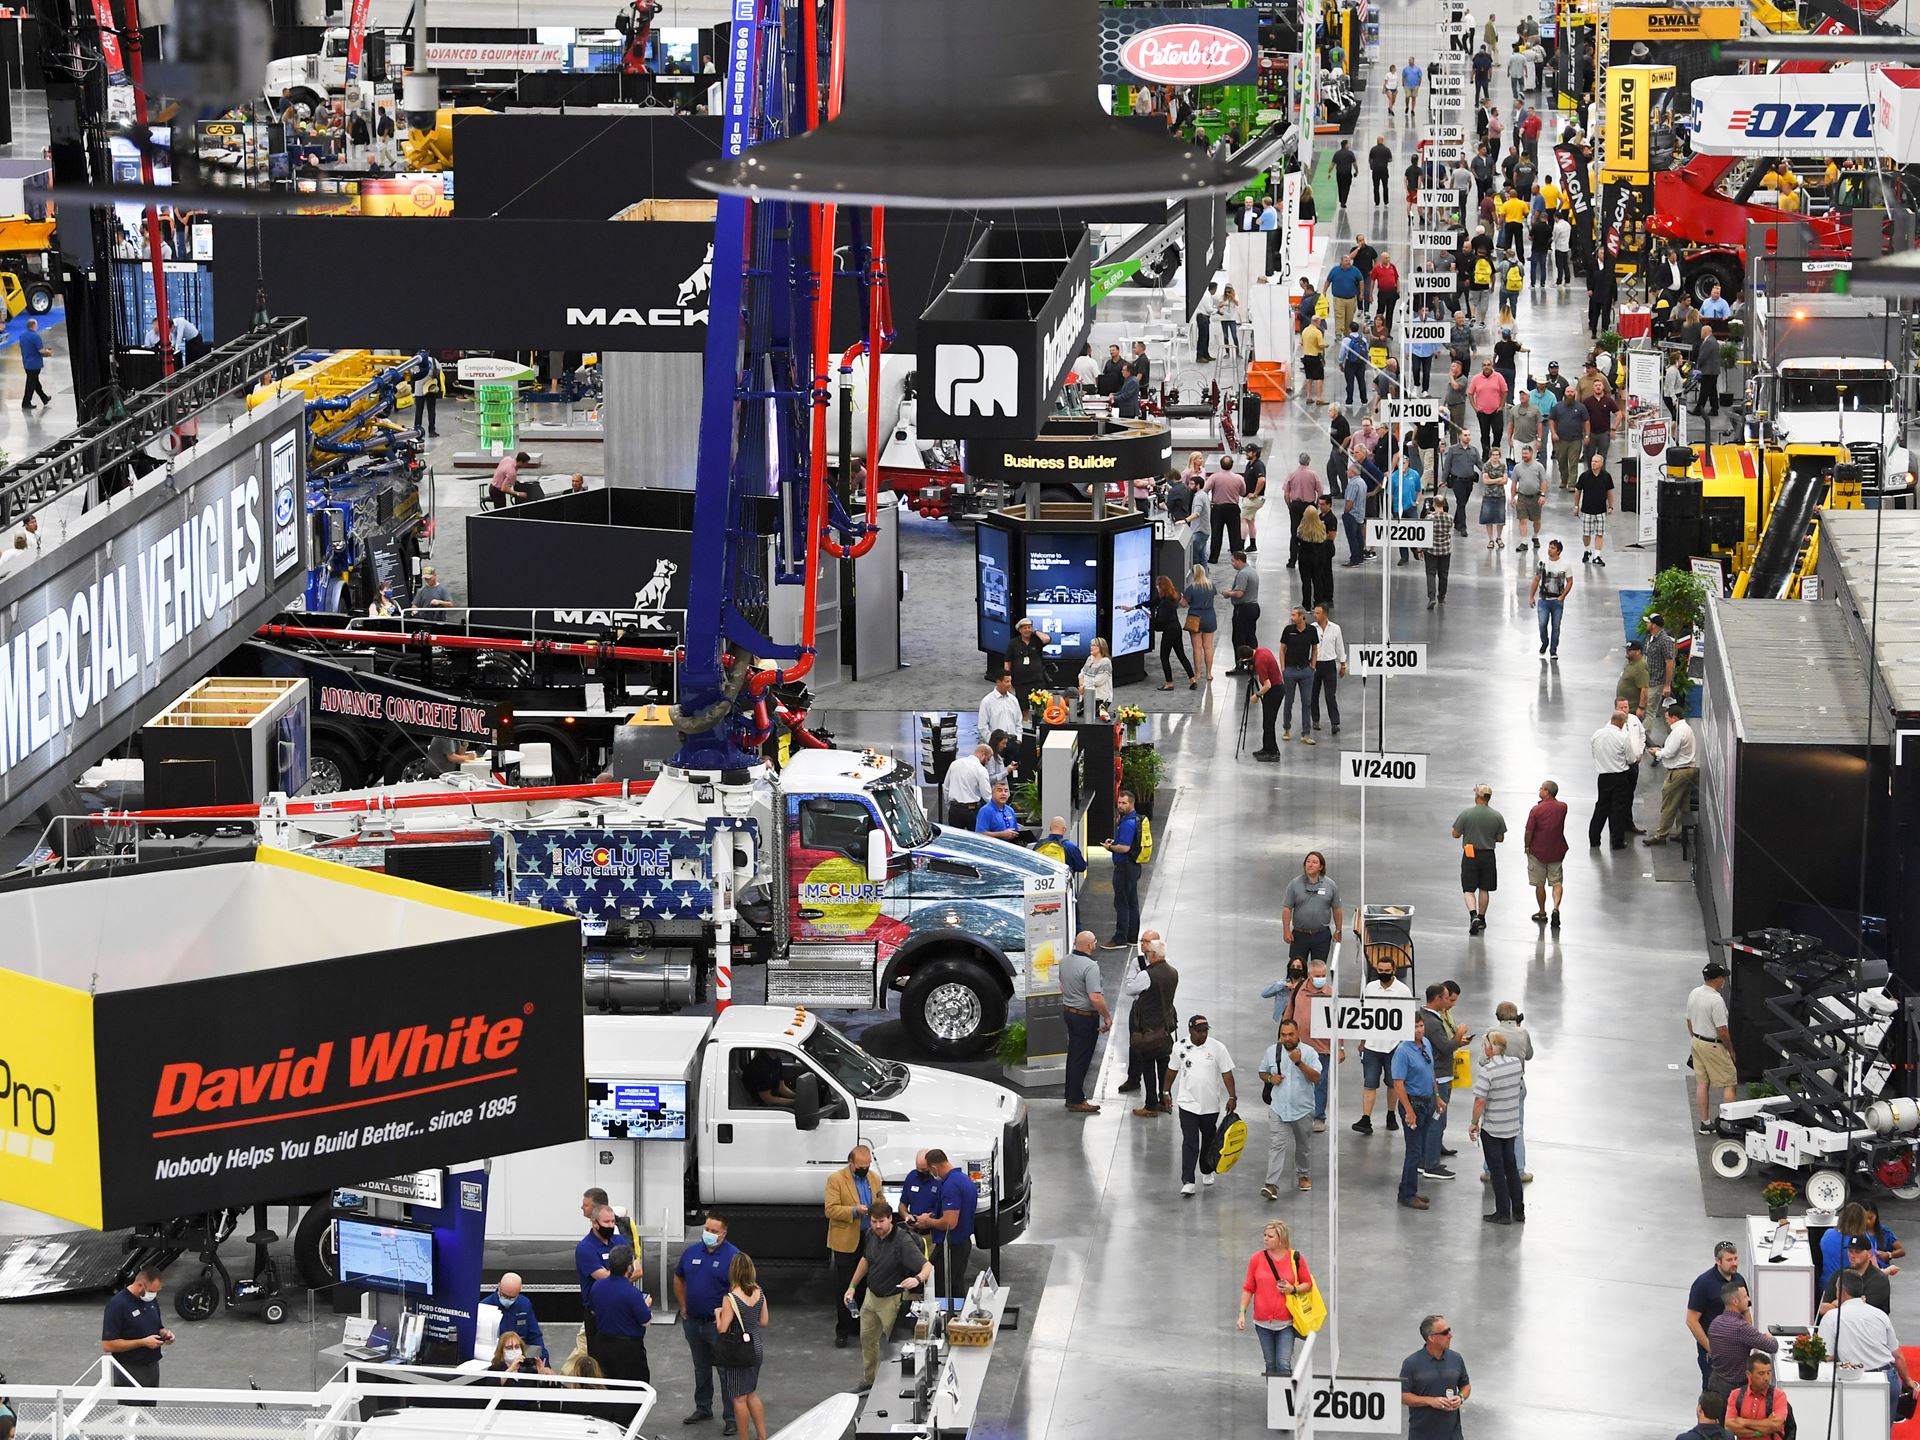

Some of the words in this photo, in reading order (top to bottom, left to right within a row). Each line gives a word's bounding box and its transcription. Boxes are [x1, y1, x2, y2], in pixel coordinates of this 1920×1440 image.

[480, 49, 539, 61] EQUIPMENT
[1138, 38, 1239, 69] Peterbilt
[733, 27, 749, 115] CONCRETE
[1621, 78, 1634, 161] DEWALT
[730, 122, 742, 155] INC
[1791, 149, 1822, 157] Concrete
[1558, 151, 1588, 214] MAGNI
[1607, 187, 1631, 255] MAGNI
[1103, 269, 1124, 289] BLEND
[1415, 276, 1451, 288] W1900
[464, 364, 494, 372] Composite
[495, 364, 516, 373] Springs
[274, 445, 294, 491] BUILT
[1004, 453, 1065, 469] Business
[1067, 455, 1118, 469] Builder
[275, 522, 296, 560] TOUGH
[138, 474, 262, 667] VEHICLES
[1359, 650, 1418, 668] W2300
[320, 687, 381, 719] ADVANCE
[386, 696, 459, 729] CONCRETE
[460, 704, 490, 734] INC.
[1352, 759, 1416, 780] W2400
[564, 848, 669, 867] McCLURE
[564, 866, 635, 876] CONCRETE
[640, 866, 670, 876] INC.
[807, 884, 884, 897] McCLURE
[1034, 878, 1055, 891] 39Z
[1324, 1006, 1403, 1031] W2500
[152, 1040, 335, 1118] David
[348, 1015, 525, 1088] White
[155, 1151, 223, 1181] Nobody
[225, 1144, 275, 1170] Helps
[279, 1136, 309, 1159] You
[313, 1128, 359, 1157] Build
[361, 1119, 424, 1147] Better...
[428, 1107, 473, 1132] since
[477, 1095, 518, 1122] 1895
[369, 1181, 391, 1192] DATA
[392, 1185, 437, 1201] SERVICES
[462, 1184, 480, 1194] BUILT
[462, 1200, 480, 1208] TOUGH
[419, 1303, 433, 1312] FORD
[434, 1306, 470, 1319] COMMERCIAL
